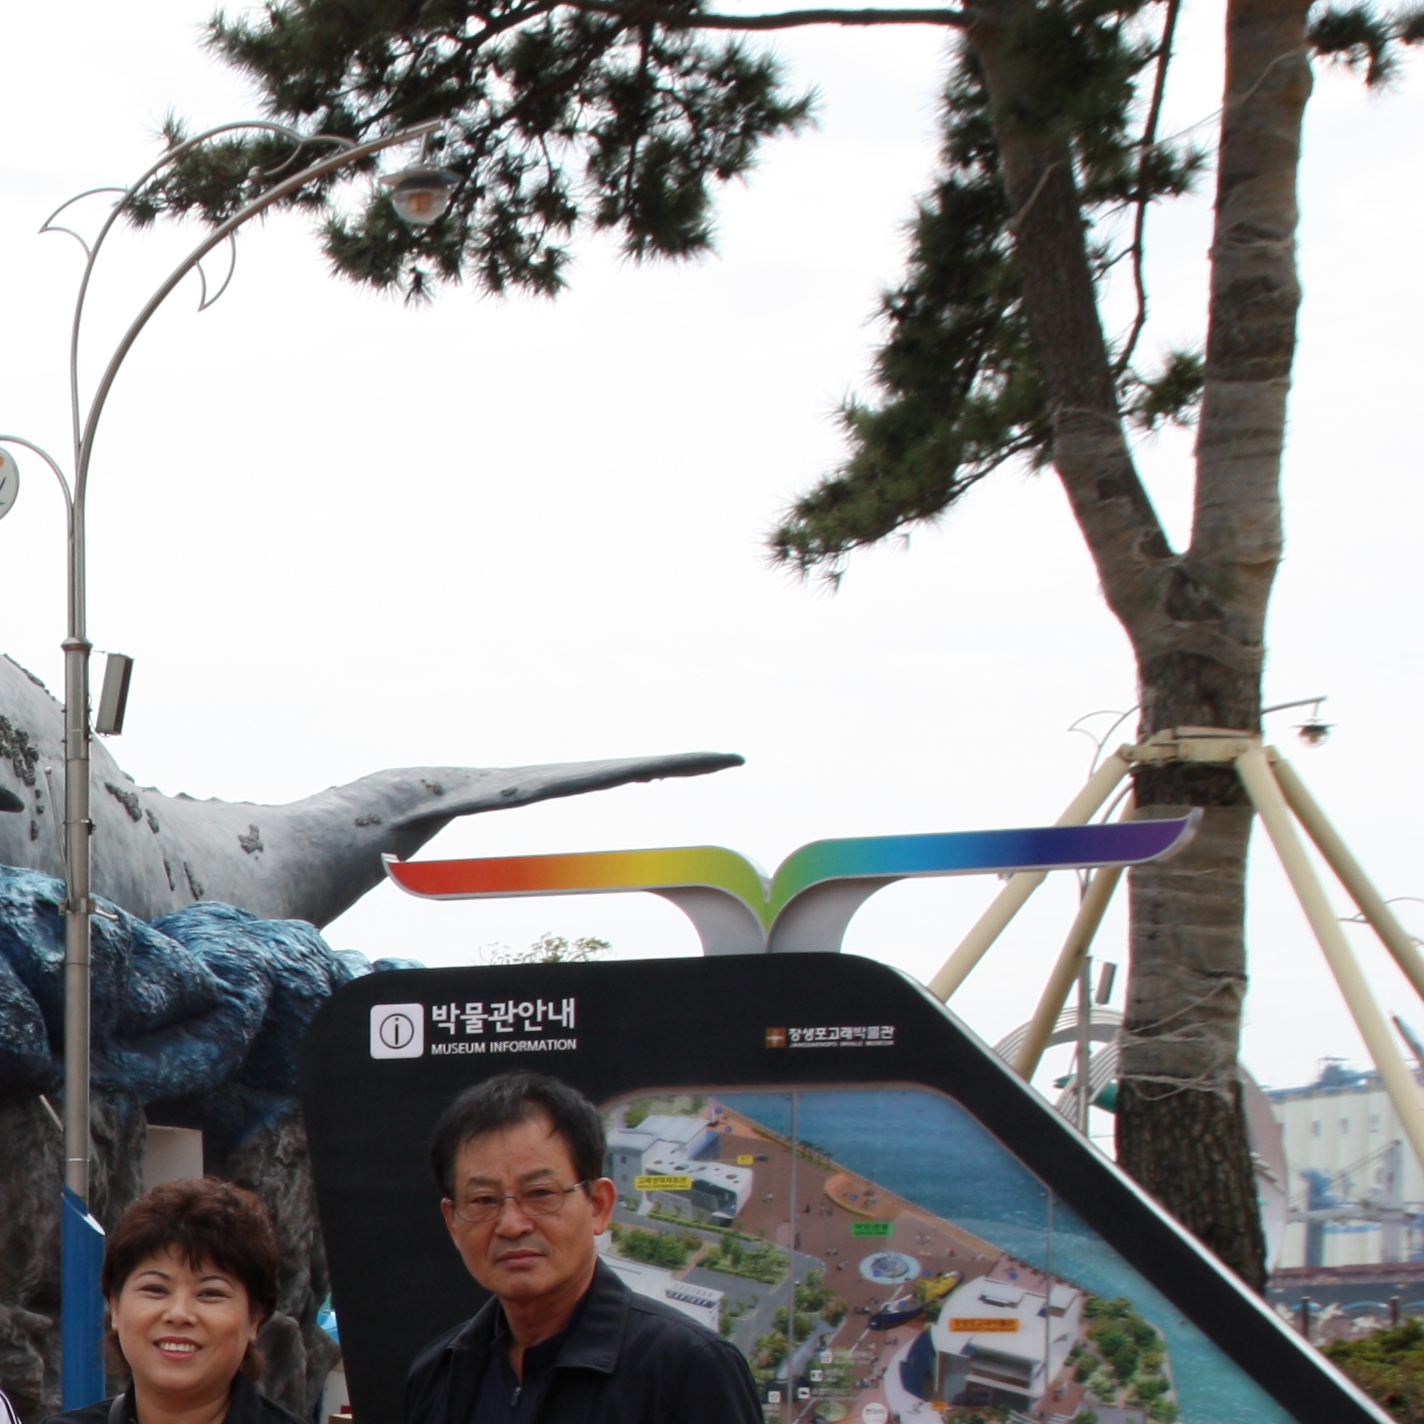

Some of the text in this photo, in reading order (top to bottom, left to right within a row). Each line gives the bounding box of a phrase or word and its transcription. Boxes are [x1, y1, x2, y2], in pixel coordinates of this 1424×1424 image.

[431, 998, 575, 1035] 박물관안내
[431, 1038, 577, 1055] MUSEUM INFORMATION
